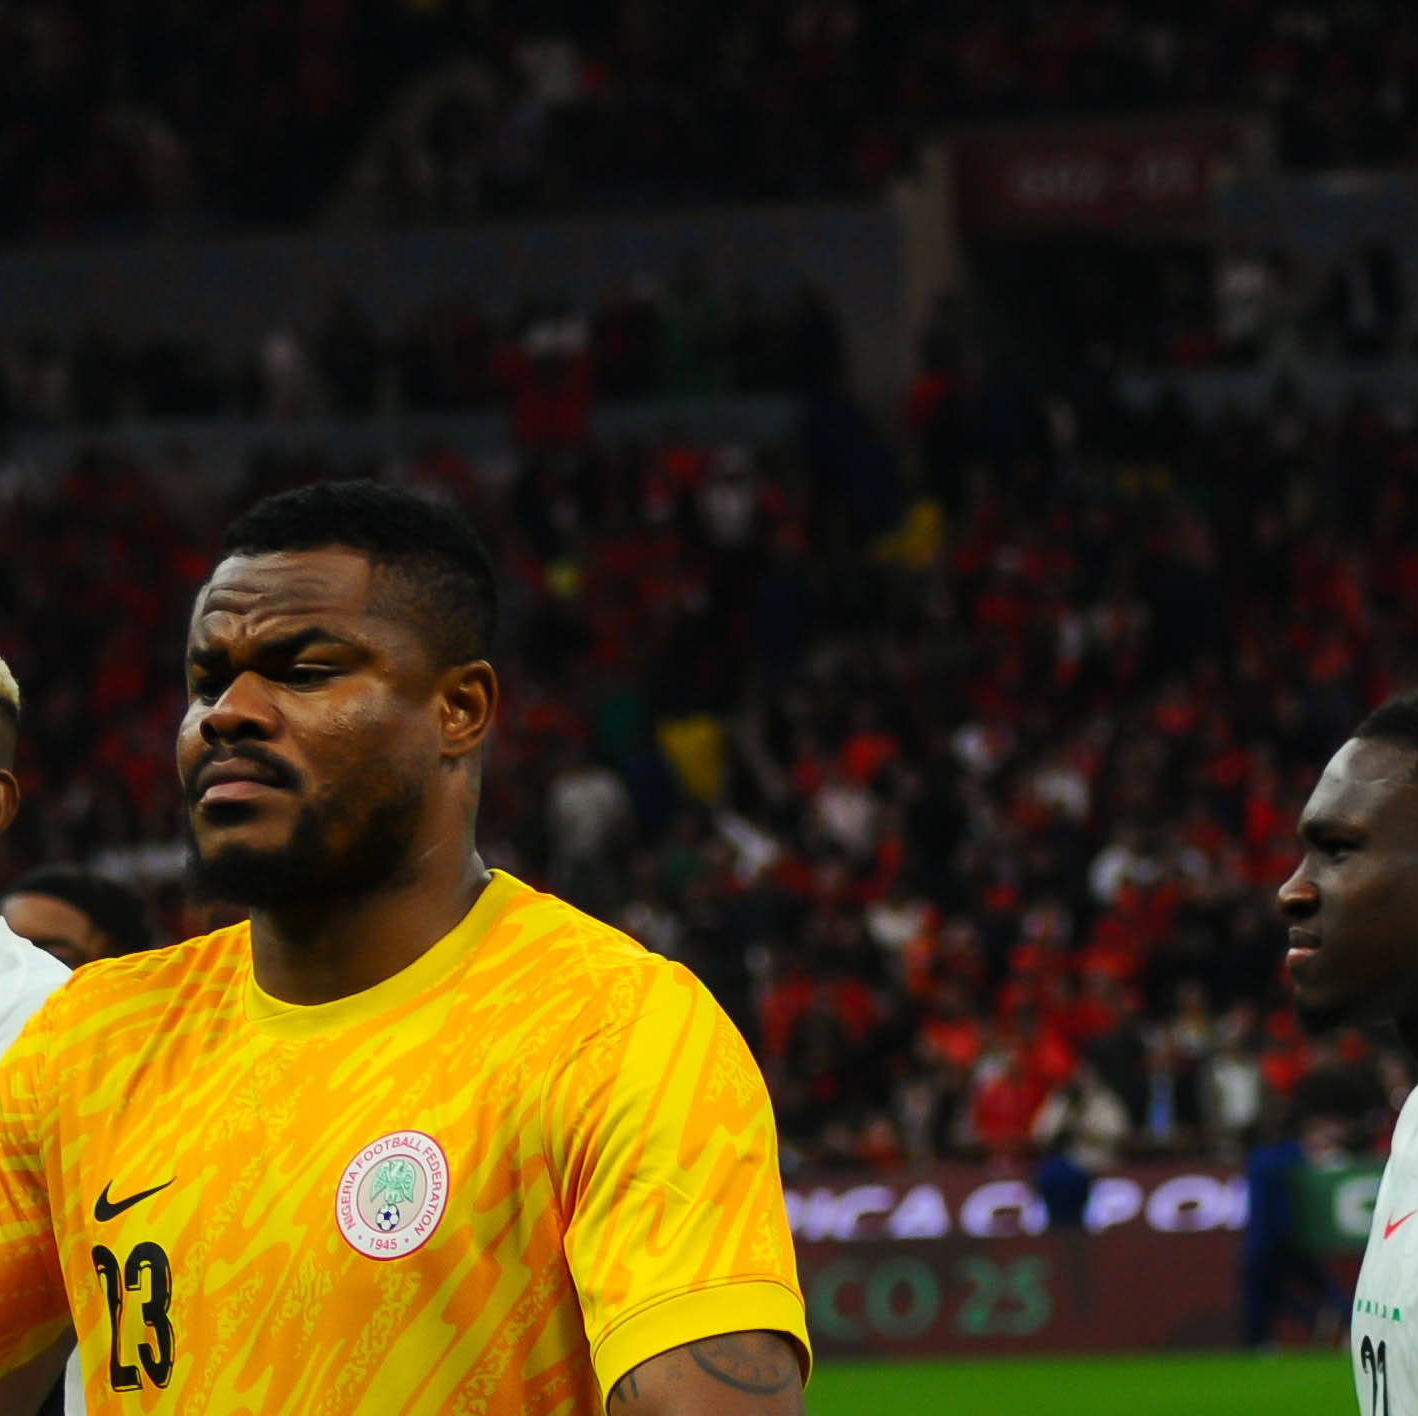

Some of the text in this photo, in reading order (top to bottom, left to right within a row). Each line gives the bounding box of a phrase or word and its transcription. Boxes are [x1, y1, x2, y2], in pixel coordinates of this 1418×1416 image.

[341, 1136, 442, 1236] NIGERIA FOOTBALL FEDERATION
[369, 1237, 398, 1251] 1945
[91, 1241, 177, 1393] 23
[951, 1254, 1055, 1338] 25
